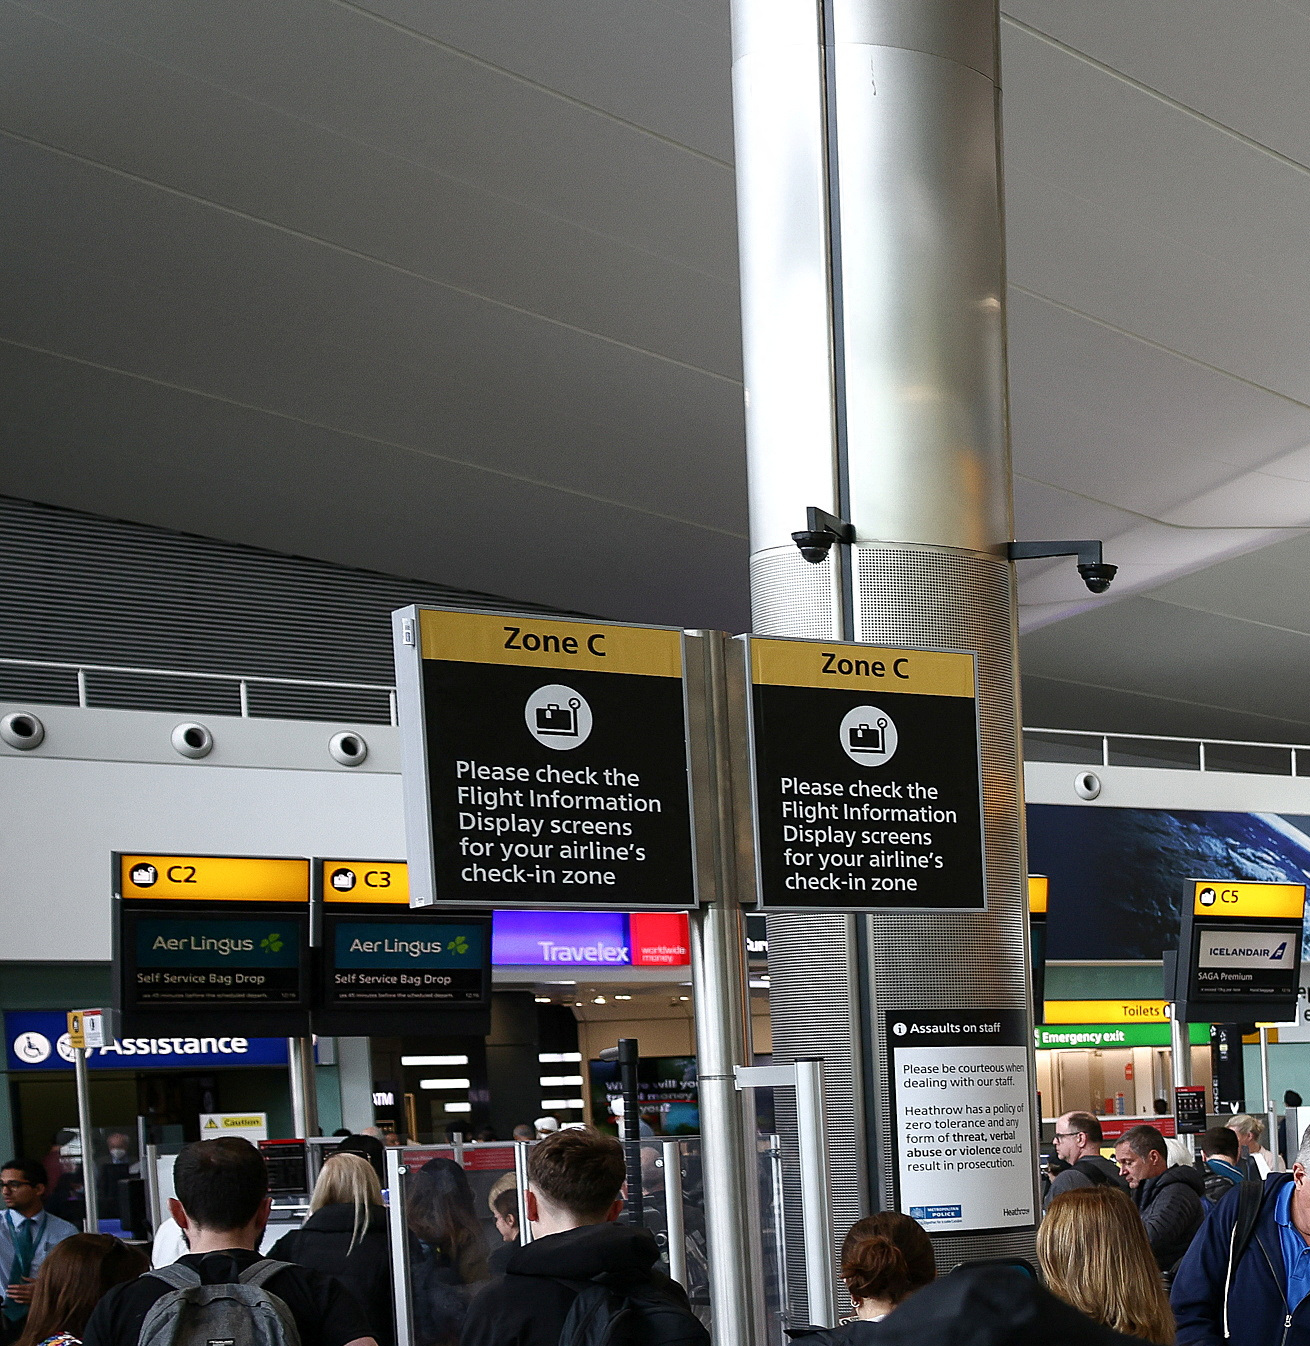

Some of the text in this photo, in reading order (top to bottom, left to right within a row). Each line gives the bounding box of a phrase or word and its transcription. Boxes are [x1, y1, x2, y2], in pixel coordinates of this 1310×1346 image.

[503, 626, 606, 657] Zone C
[821, 652, 910, 680] Zone C
[455, 760, 640, 787] Please check the
[780, 777, 939, 800] Please check the
[457, 785, 662, 814] Flight Information
[781, 800, 957, 824] Flight Information
[459, 812, 633, 838] Display screens
[783, 824, 932, 848] Display screens
[460, 836, 646, 864] for your airline's
[783, 848, 944, 872] for your airline's
[166, 863, 197, 885] C2
[364, 869, 391, 889] C3
[461, 862, 616, 886] check-in zone
[785, 871, 918, 892] check-in zone
[1221, 890, 1239, 903] C5
[153, 935, 253, 955] Aer Lingus
[350, 938, 442, 957] Aer Lingus
[538, 941, 629, 963] Travelex
[641, 945, 686, 955] worldwide
[1210, 948, 1270, 957] ICELANDAIR
[641, 954, 674, 964] money
[137, 973, 265, 987] Self Service Bag Drop
[335, 974, 452, 987] Self Service Bag Drop
[1198, 972, 1252, 981] SAGA Premium
[1122, 1005, 1160, 1017] Toilets
[910, 1023, 1000, 1034] Assaults on staff
[1042, 1030, 1125, 1046] Emergency exit
[903, 1063, 1024, 1074] Please be courteous when
[903, 1076, 1015, 1089] dealing with our staff.
[905, 1103, 1024, 1116] Heathrow has a policy of
[224, 1118, 260, 1127] Caution
[906, 1118, 1019, 1130] zero tolerance and any
[906, 1131, 1015, 1144] form of threat, verbal
[907, 1144, 1022, 1158] abuse or violence could
[907, 1159, 1015, 1172] result in prosecution.
[1003, 1208, 1029, 1216] Heathrow
